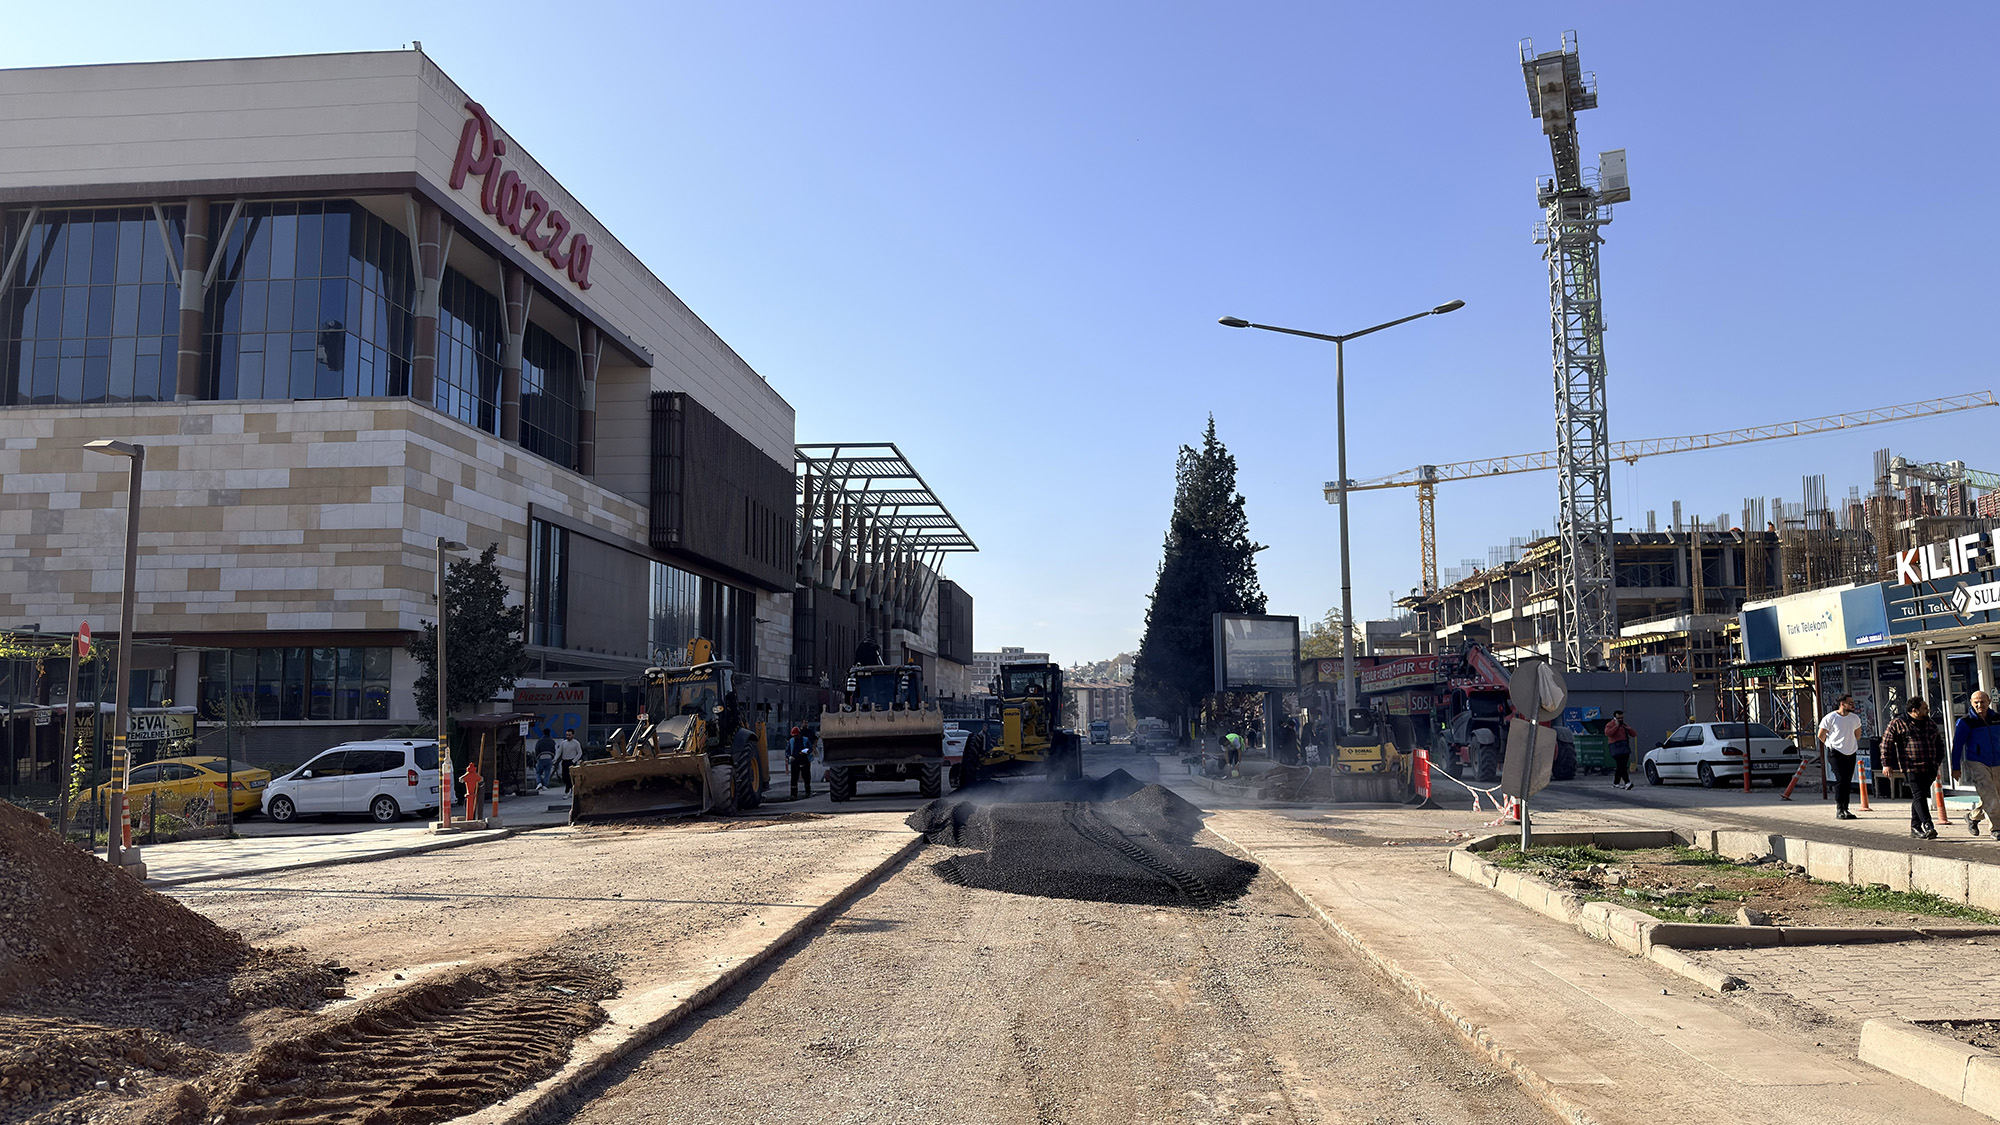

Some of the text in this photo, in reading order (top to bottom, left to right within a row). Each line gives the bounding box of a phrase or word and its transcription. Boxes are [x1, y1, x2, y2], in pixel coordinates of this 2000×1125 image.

[449, 101, 594, 291] Piazza
[1896, 532, 1980, 585] KILIF
[1787, 620, 1828, 635] Türk Telekom
[518, 689, 584, 701] Piazza AVM
[1412, 695, 1433, 711] SOSL
